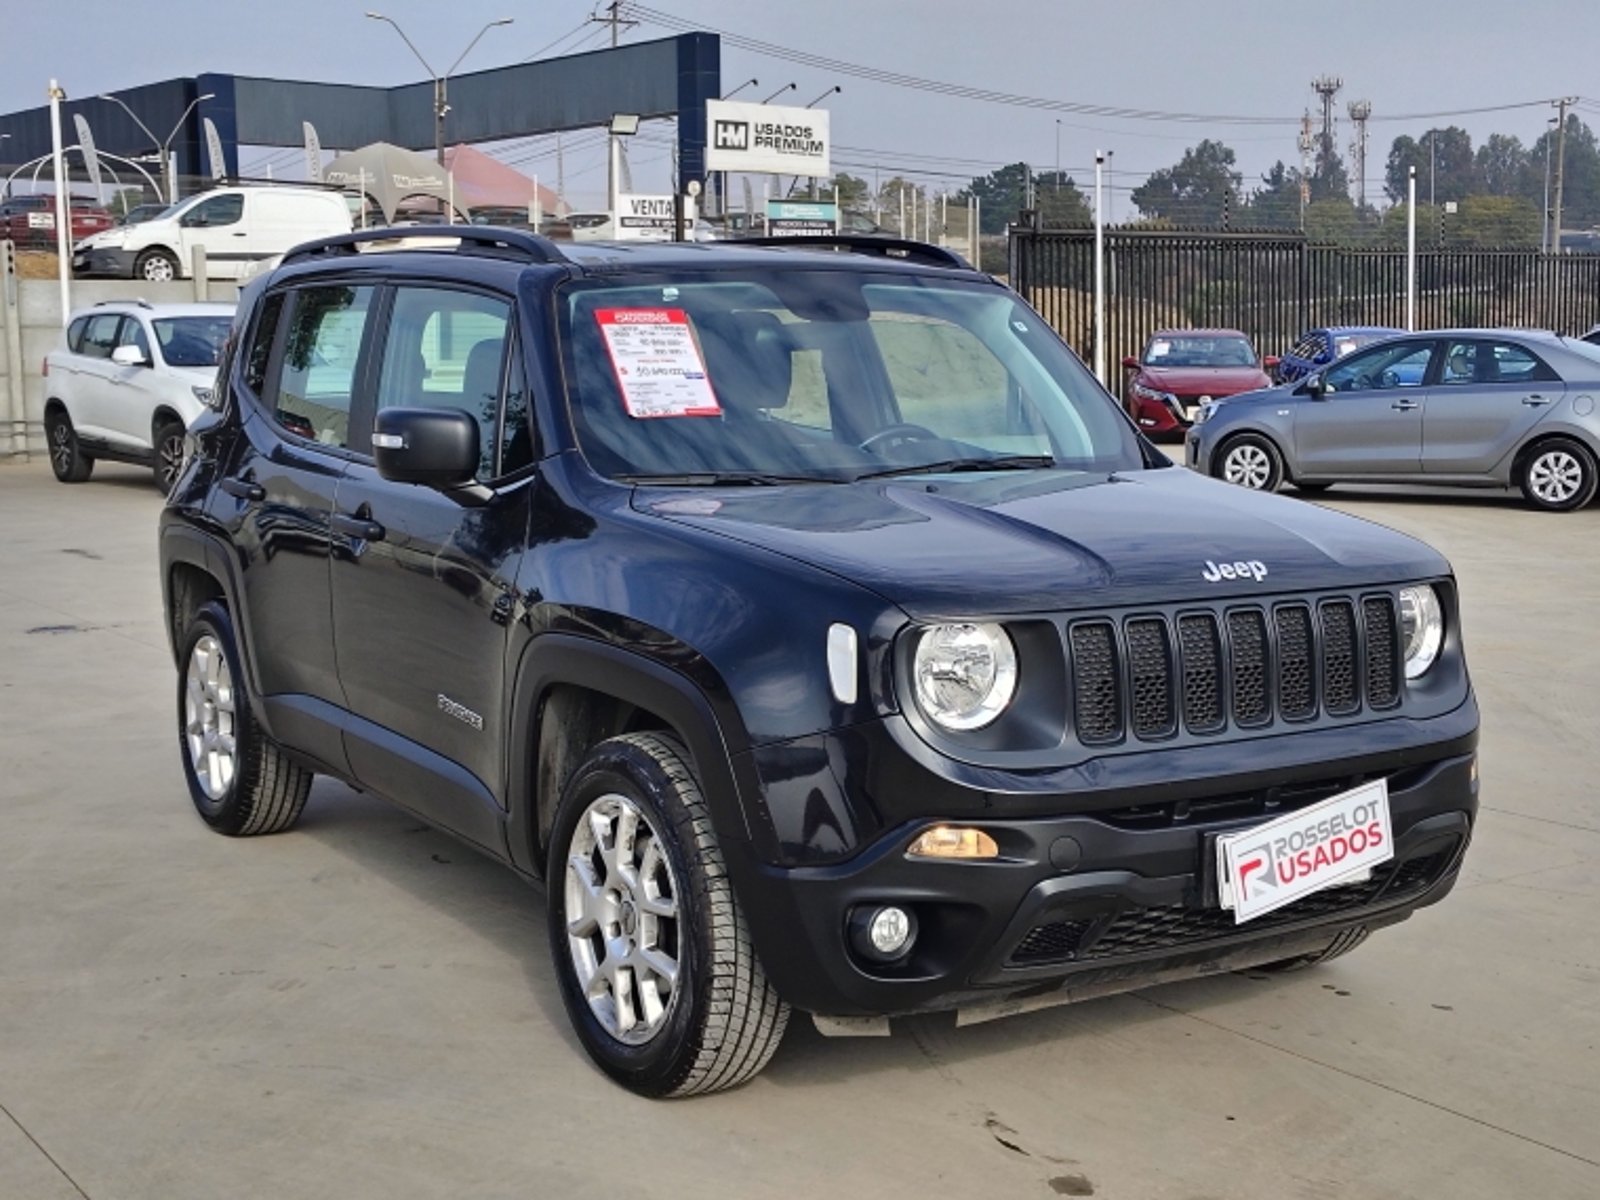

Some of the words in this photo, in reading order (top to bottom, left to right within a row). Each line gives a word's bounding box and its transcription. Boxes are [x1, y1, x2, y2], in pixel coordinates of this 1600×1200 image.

[716, 121, 747, 150] HM
[755, 123, 813, 139] USADOS
[754, 137, 824, 153] PREMIUM
[1202, 560, 1268, 582] Jeep
[1275, 801, 1379, 859] ROSSELOT
[1278, 822, 1383, 884] USADOS
